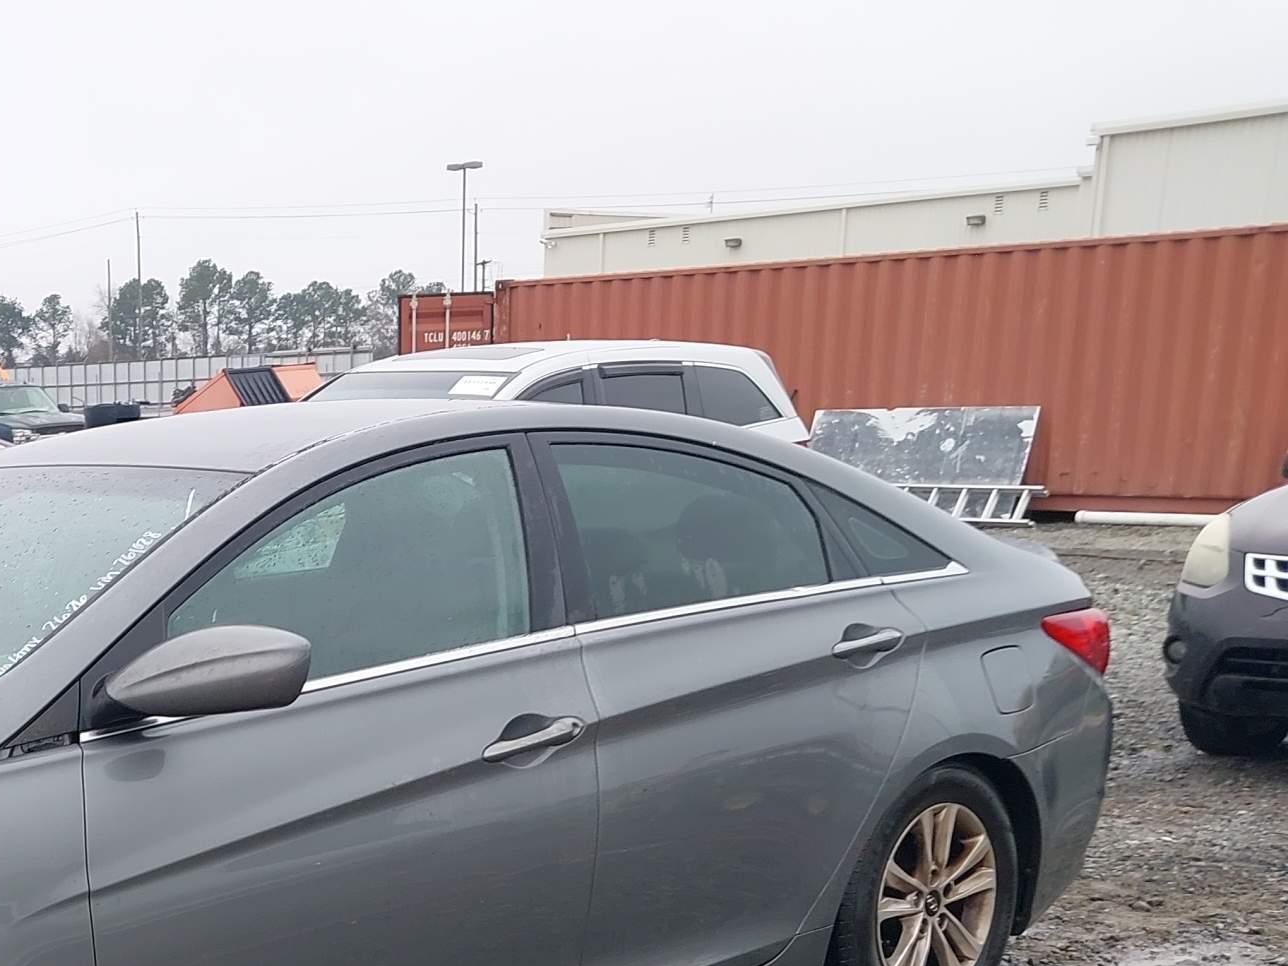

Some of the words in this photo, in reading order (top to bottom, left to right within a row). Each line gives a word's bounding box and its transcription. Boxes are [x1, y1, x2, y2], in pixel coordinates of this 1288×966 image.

[424, 331, 444, 343] TCLU
[452, 330, 481, 342] 400146
[483, 329, 490, 341] 7
